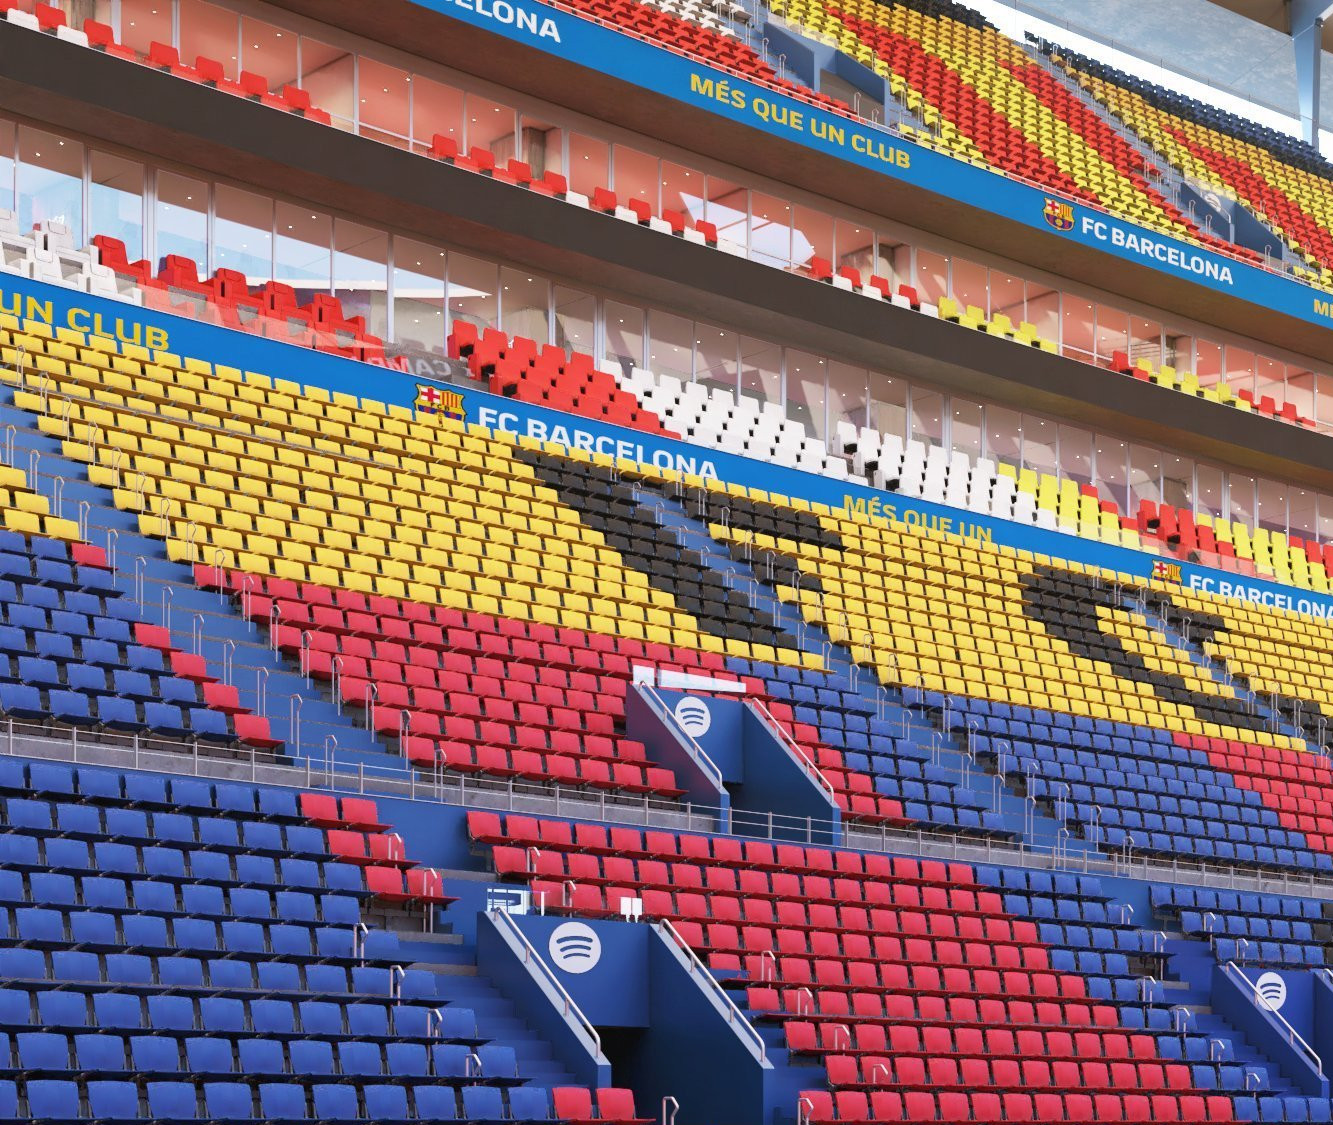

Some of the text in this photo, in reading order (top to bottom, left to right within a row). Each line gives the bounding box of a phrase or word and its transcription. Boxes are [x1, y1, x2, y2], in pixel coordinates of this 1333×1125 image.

[690, 73, 910, 168] MÉS QUE UN CLUB
[1082, 217, 1233, 284] FC BARCELONA
[66, 307, 169, 350] CLUB
[479, 406, 718, 479] FC BARCELONA
[843, 494, 992, 542] MÉS QUE UN
[1190, 574, 1214, 594] FC
